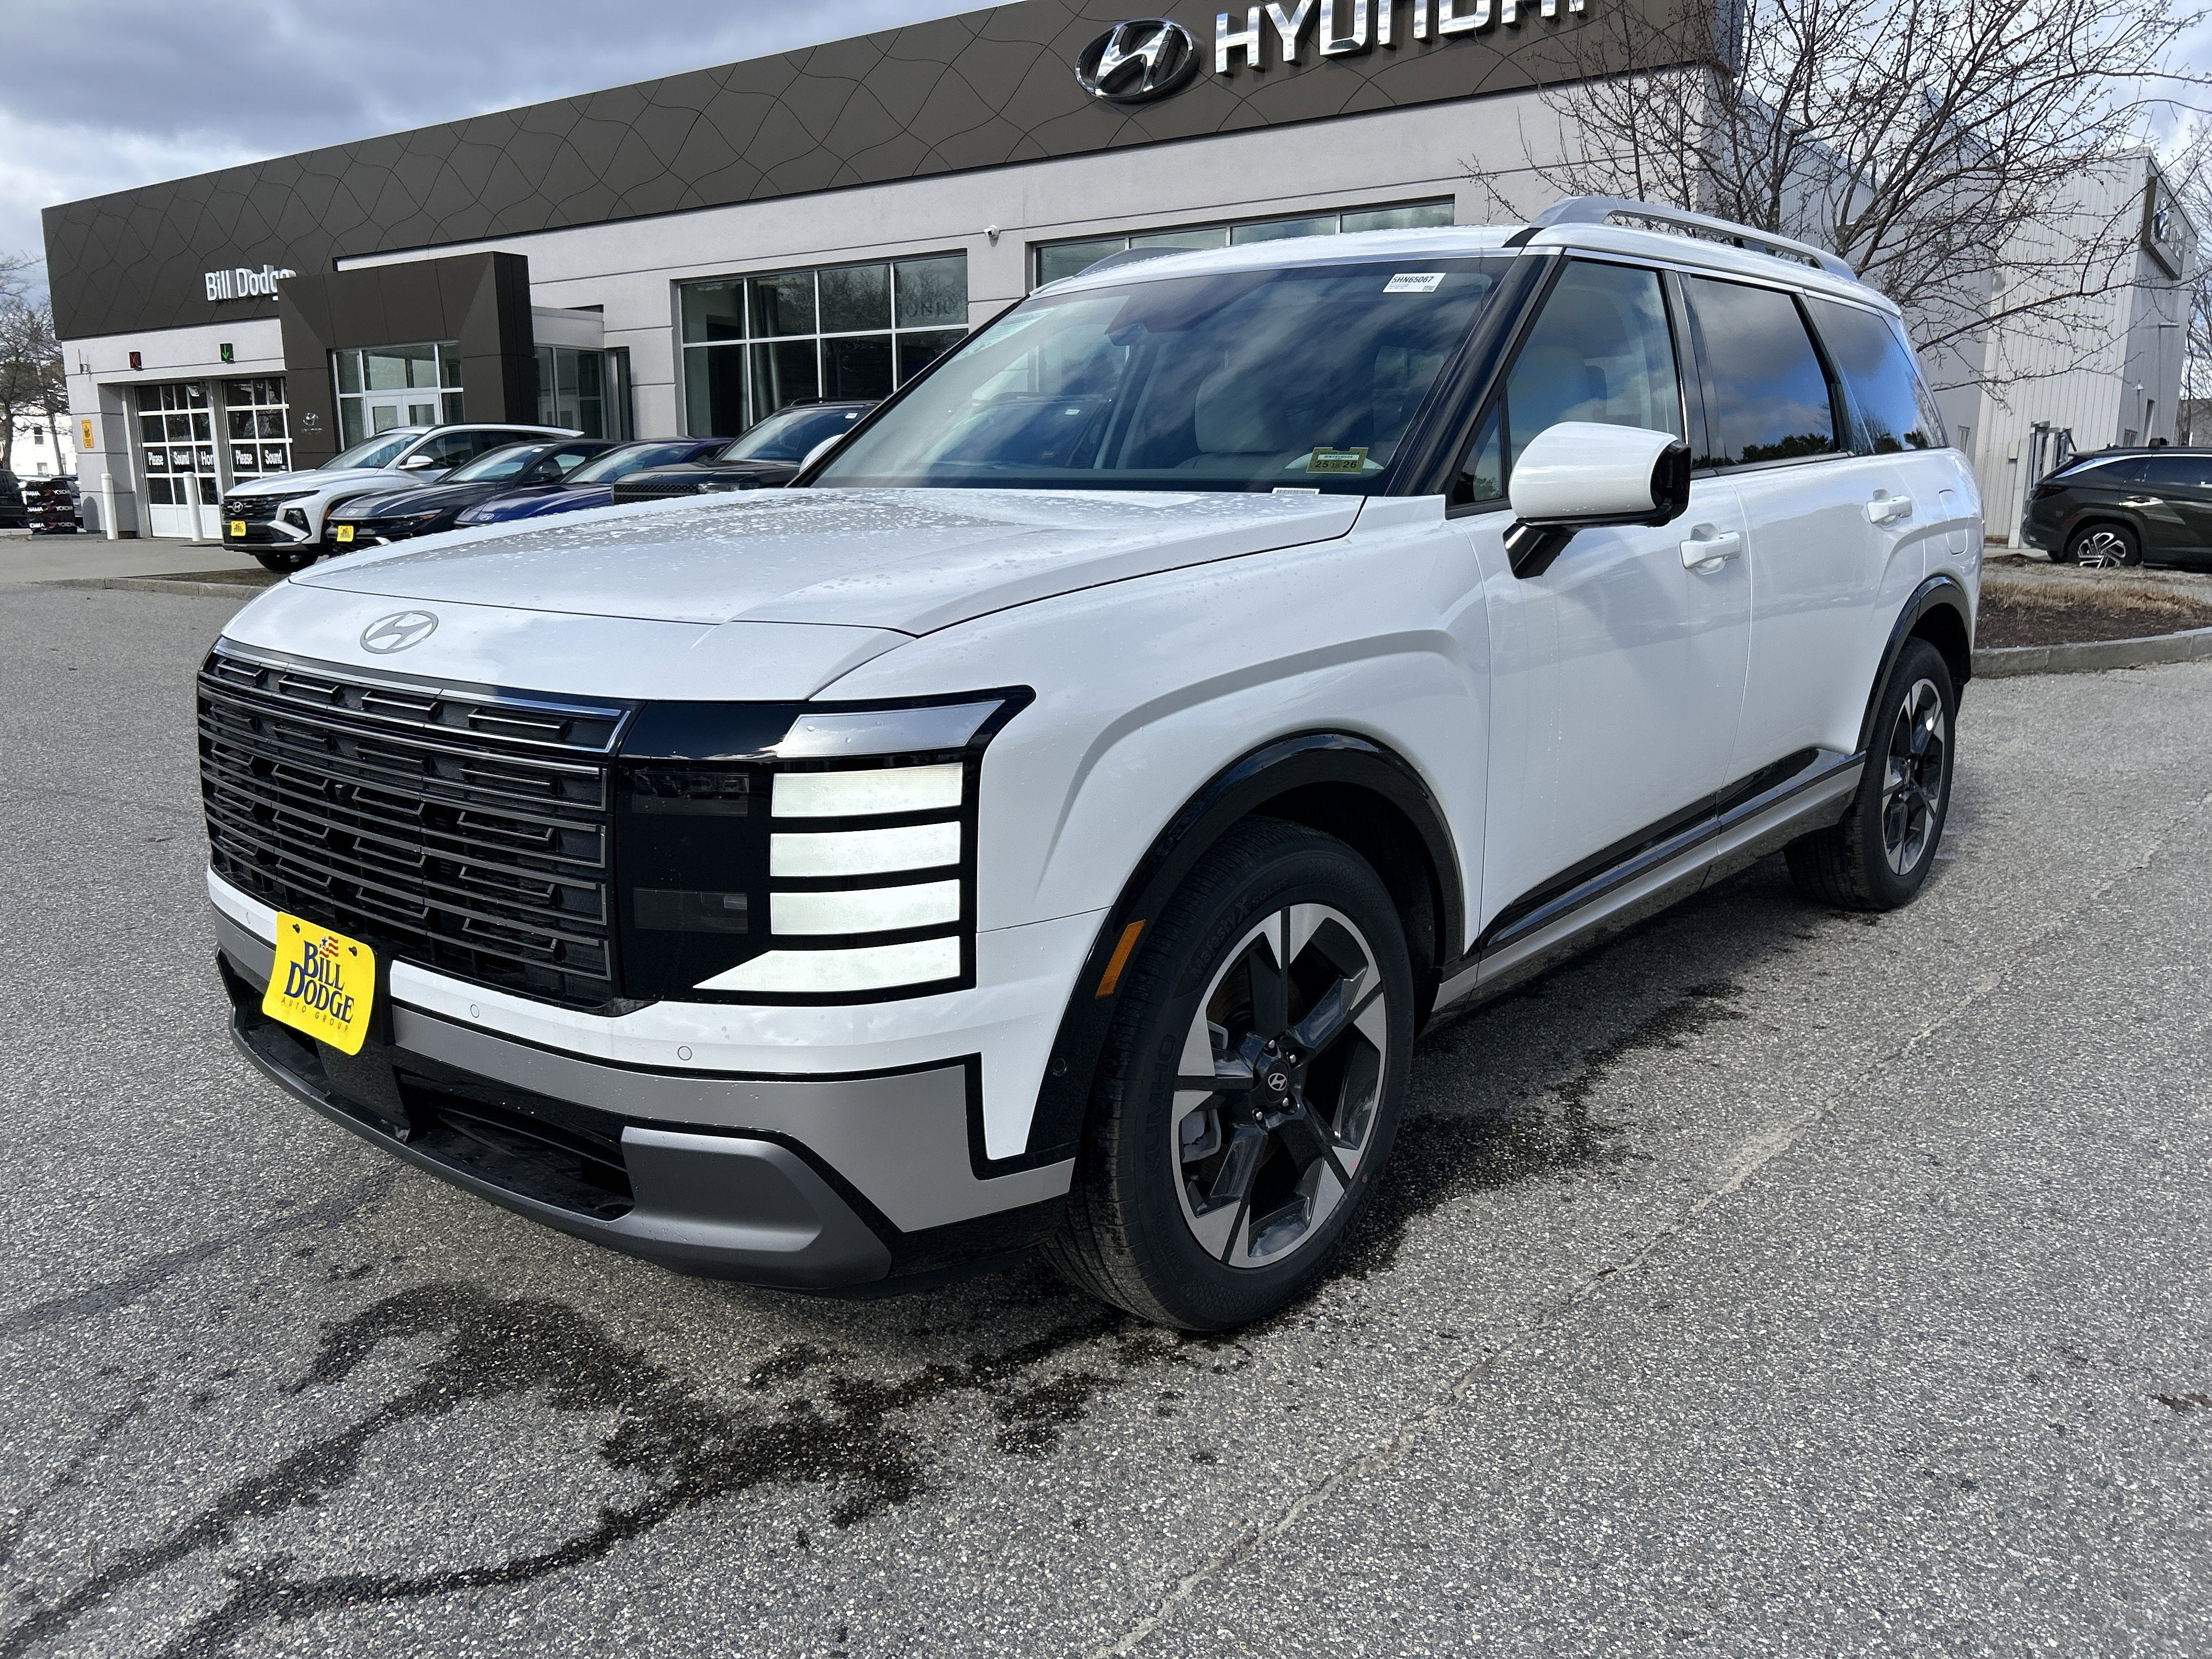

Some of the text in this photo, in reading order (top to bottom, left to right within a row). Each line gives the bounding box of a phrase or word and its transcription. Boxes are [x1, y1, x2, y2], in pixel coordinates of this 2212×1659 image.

[205, 269, 236, 301] Bill
[148, 451, 215, 466] Please Sound Hor
[235, 449, 283, 465] Please Sound
[303, 940, 345, 992] BILL
[284, 960, 354, 1023] DODGE
[281, 996, 349, 1033] AUTO GROUP
[1144, 1034, 1176, 1178] KUMHO
